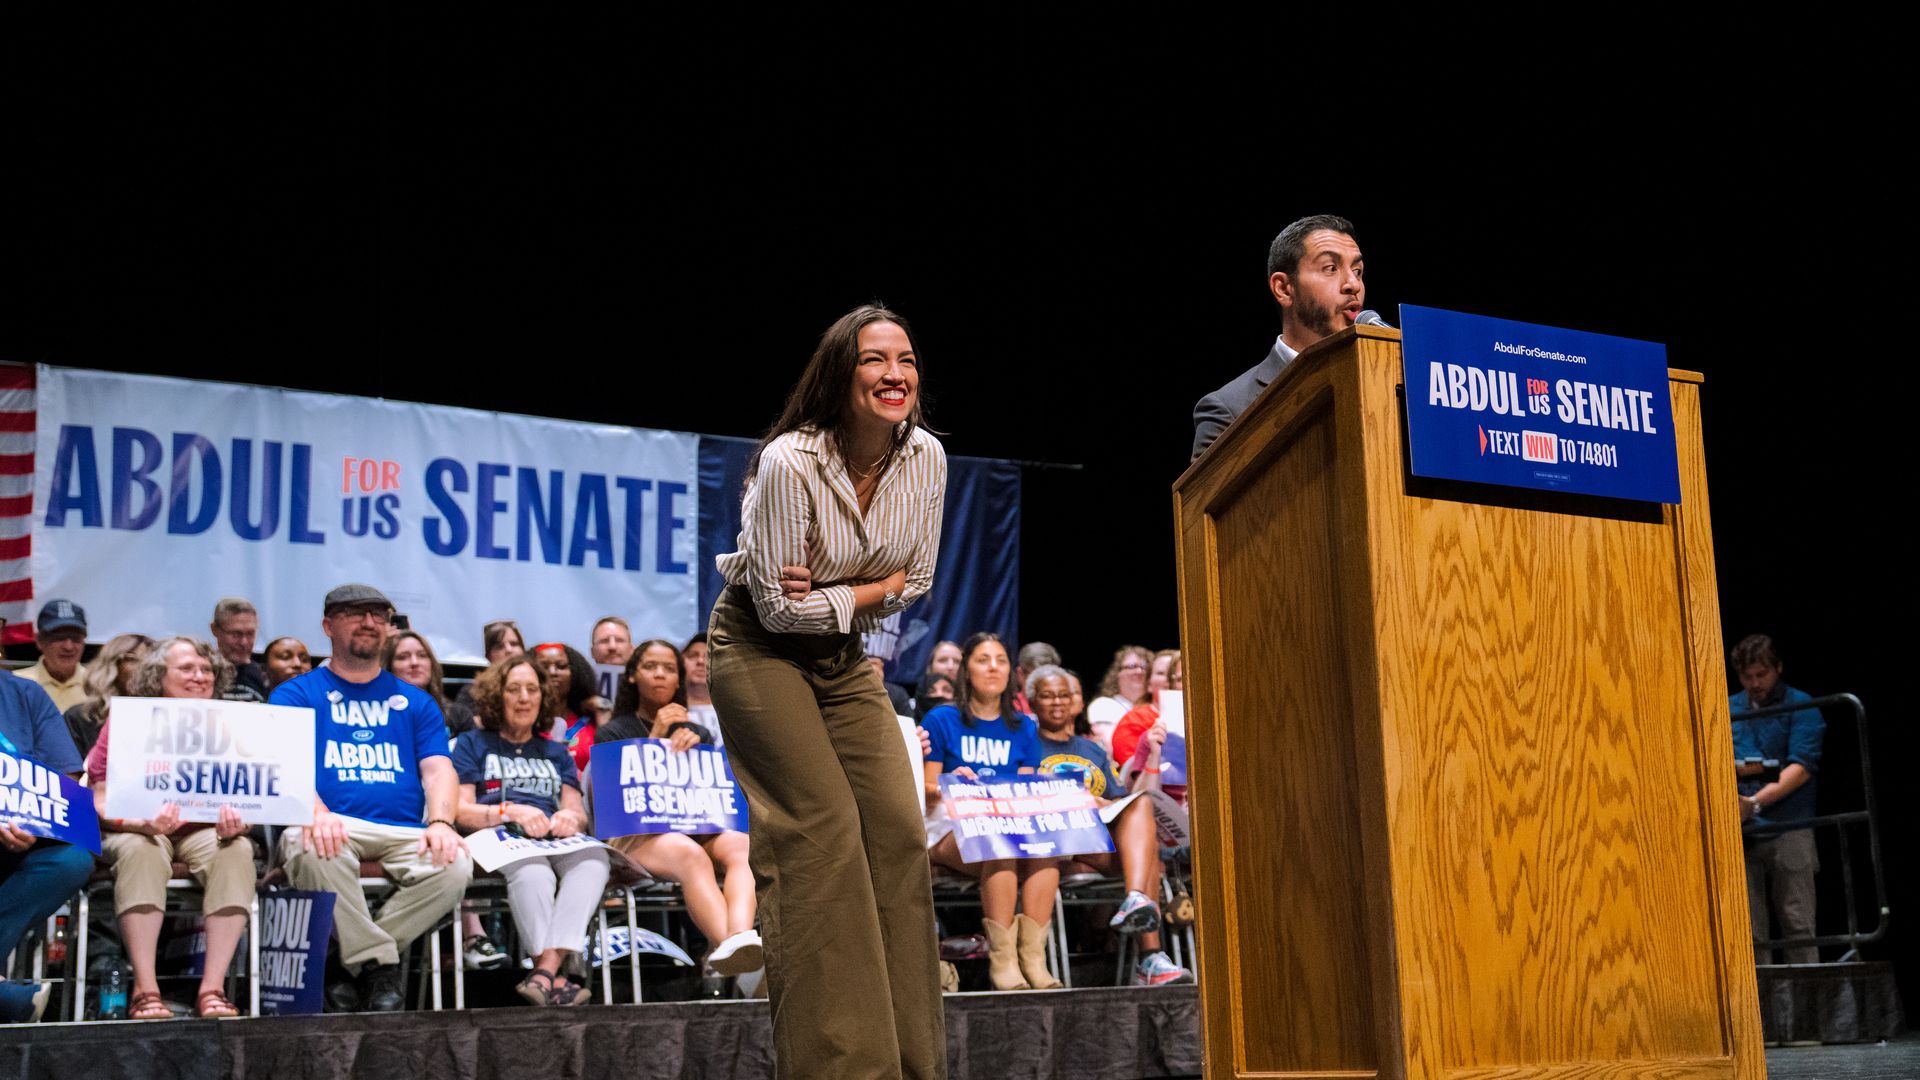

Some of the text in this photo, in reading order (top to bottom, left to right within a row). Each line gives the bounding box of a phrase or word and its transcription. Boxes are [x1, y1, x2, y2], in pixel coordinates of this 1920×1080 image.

[1494, 342, 1587, 365] AbdulForSenate.com
[1429, 361, 1657, 434] ABDUL FOR US SENATE
[1488, 429, 1618, 468] TEXT WIN TO 74801
[44, 424, 689, 574] ABDUL FOR US SENATE
[331, 700, 390, 728] UAW
[324, 739, 404, 773] ABDUL
[484, 753, 562, 780] ABDUL
[620, 744, 735, 788] ABDUL
[961, 735, 1011, 766] UAW
[0, 752, 70, 806] DUL
[144, 773, 171, 791] US
[145, 759, 281, 797] FOR SENATE
[0, 785, 70, 828] NATE
[624, 797, 648, 814] US
[648, 784, 739, 815] SENATE
[259, 897, 313, 950] BDUL
[260, 951, 309, 990] SENATE
